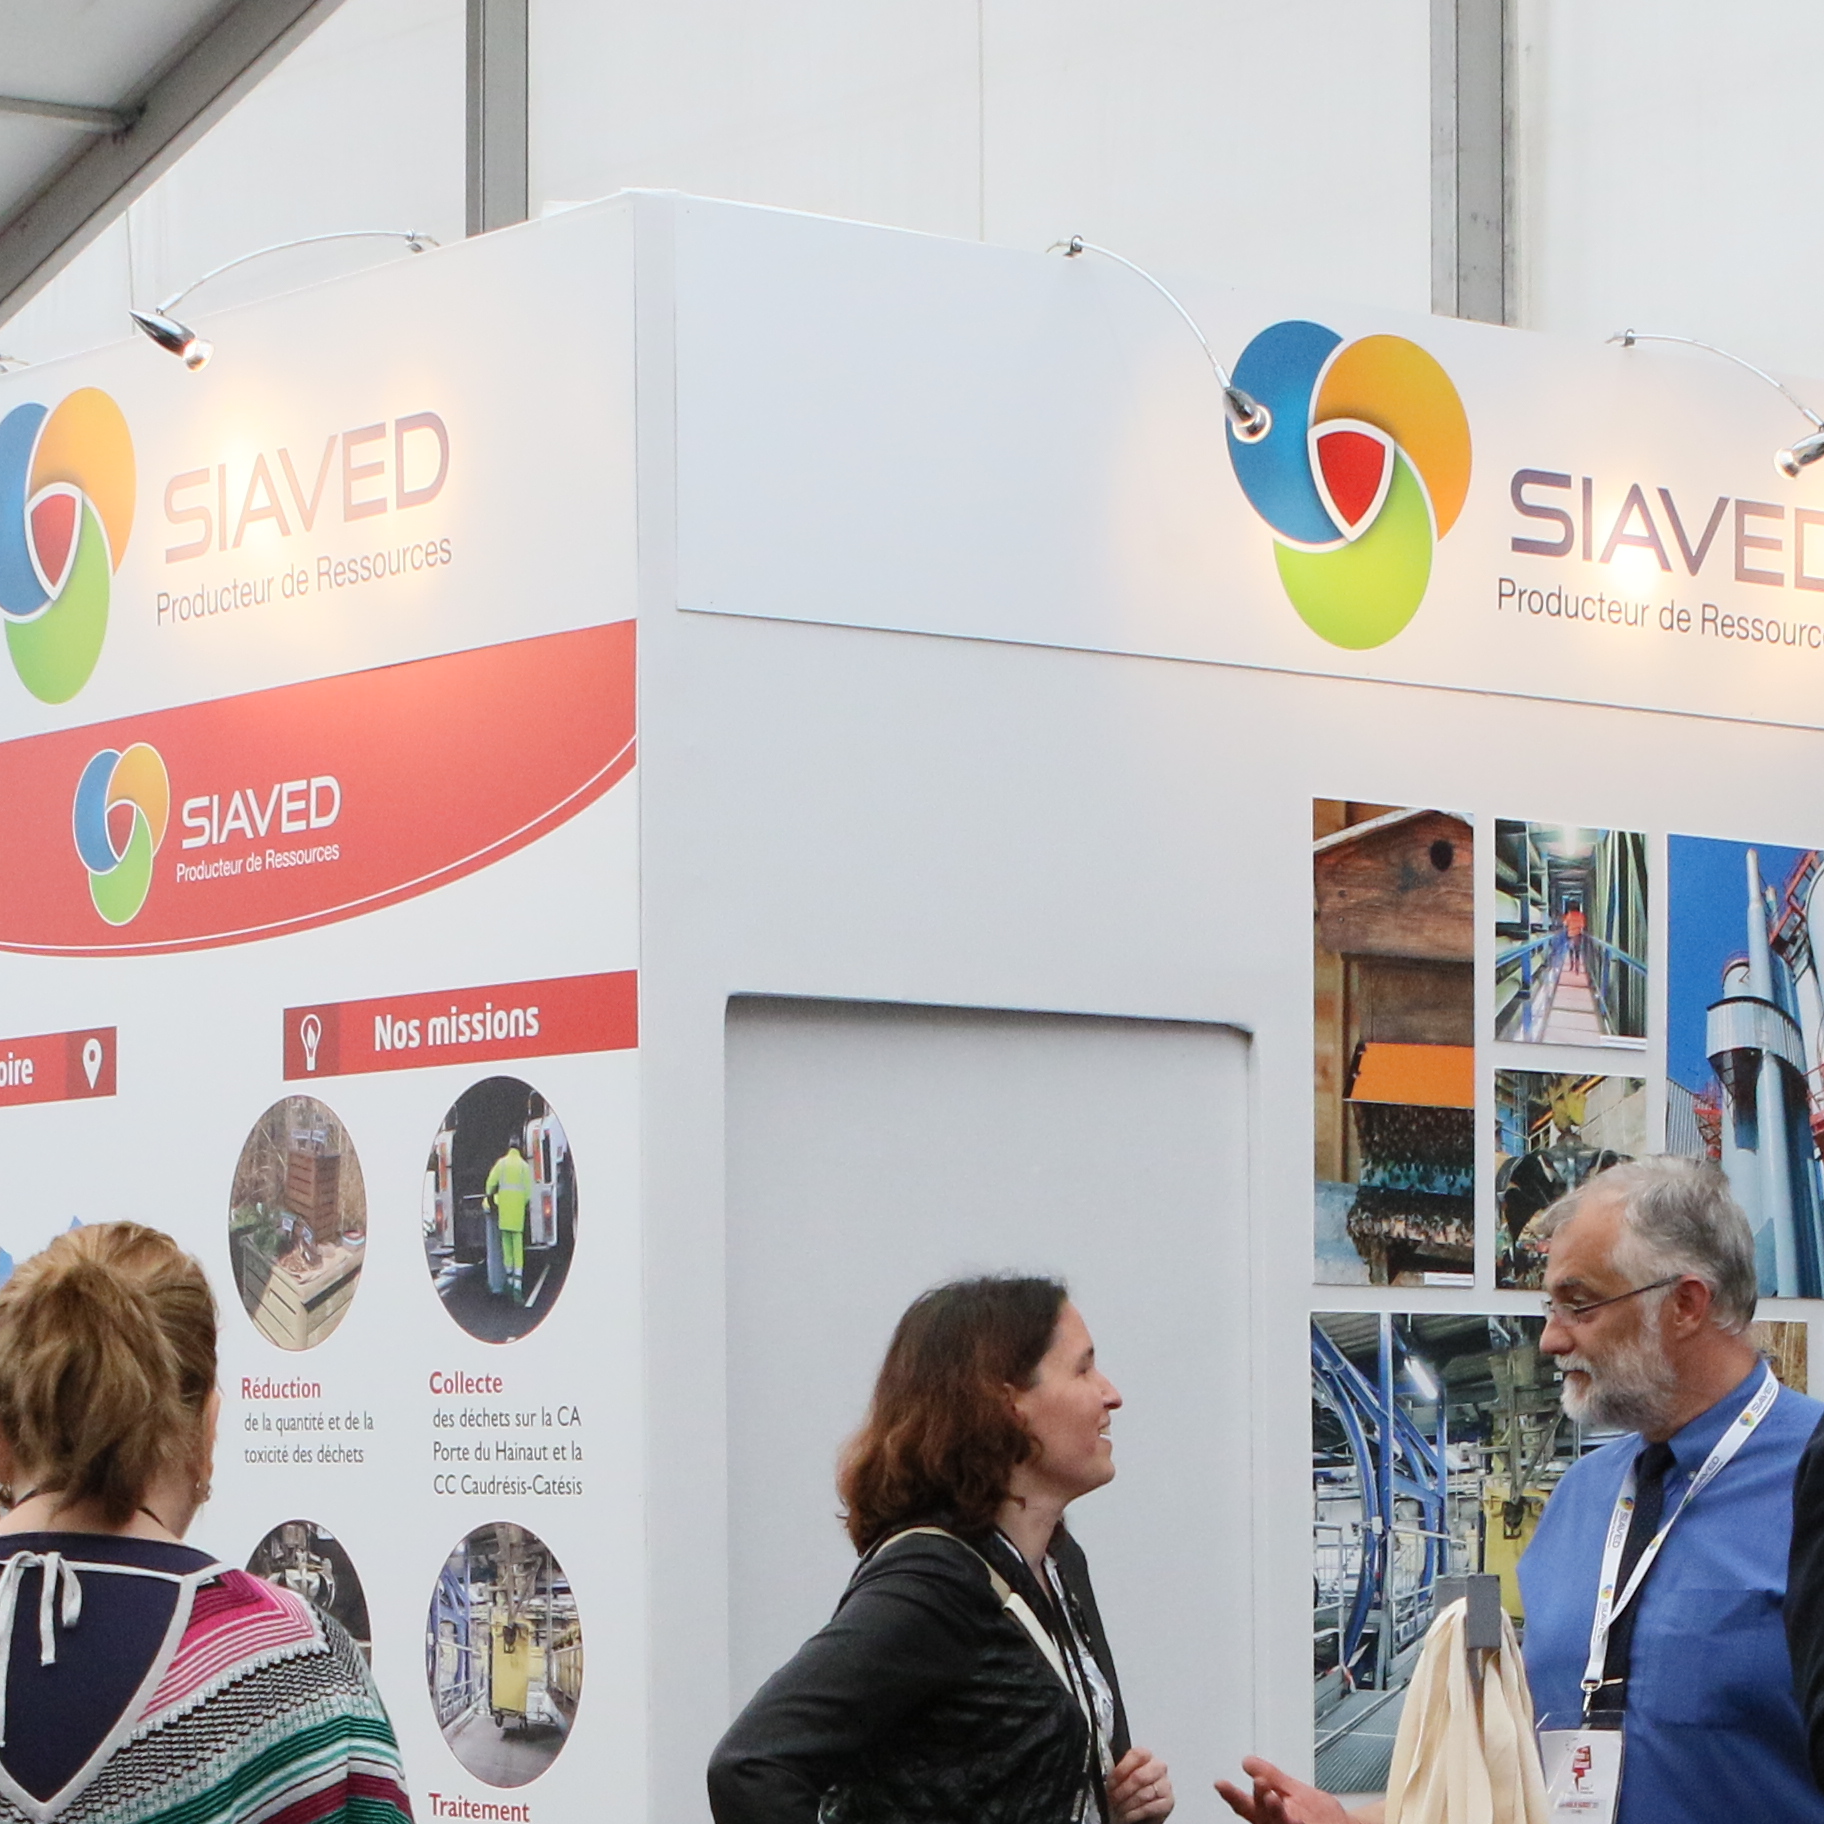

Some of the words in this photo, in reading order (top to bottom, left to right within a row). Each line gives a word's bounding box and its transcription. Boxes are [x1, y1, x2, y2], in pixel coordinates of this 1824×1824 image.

[163, 411, 451, 564] SIAVED
[156, 572, 274, 627] Producteur
[281, 564, 310, 599] de
[316, 536, 453, 591] Ressources
[1497, 577, 1650, 630] Producteur
[1659, 600, 1692, 635] de
[181, 775, 343, 850] SIAVED
[176, 857, 242, 884] Producteur
[246, 852, 262, 875] de
[265, 843, 340, 873] Ressources
[374, 1013, 423, 1052] Nos
[427, 1004, 540, 1048] missions
[241, 1376, 321, 1400] Réduction
[429, 1371, 503, 1395] Collecte
[244, 1412, 259, 1432] de
[262, 1412, 272, 1432] la
[276, 1411, 324, 1436] quantité
[328, 1413, 341, 1431] et
[344, 1411, 360, 1431] de
[363, 1410, 374, 1431] la
[432, 1408, 455, 1429] des
[459, 1407, 511, 1428] déchets
[515, 1411, 536, 1428] sur
[541, 1405, 552, 1427] la
[557, 1405, 582, 1427] CA
[244, 1445, 289, 1464] toxicité
[292, 1444, 313, 1464] des
[316, 1443, 364, 1464] déchets
[433, 1441, 470, 1462] Porte
[474, 1441, 491, 1462] du
[495, 1441, 549, 1462] Hainaut
[553, 1443, 567, 1461] et
[571, 1440, 583, 1461] la
[433, 1474, 457, 1496] CC
[461, 1474, 583, 1496] Caudrésis-Catésis
[428, 1792, 531, 1824] Traitement
